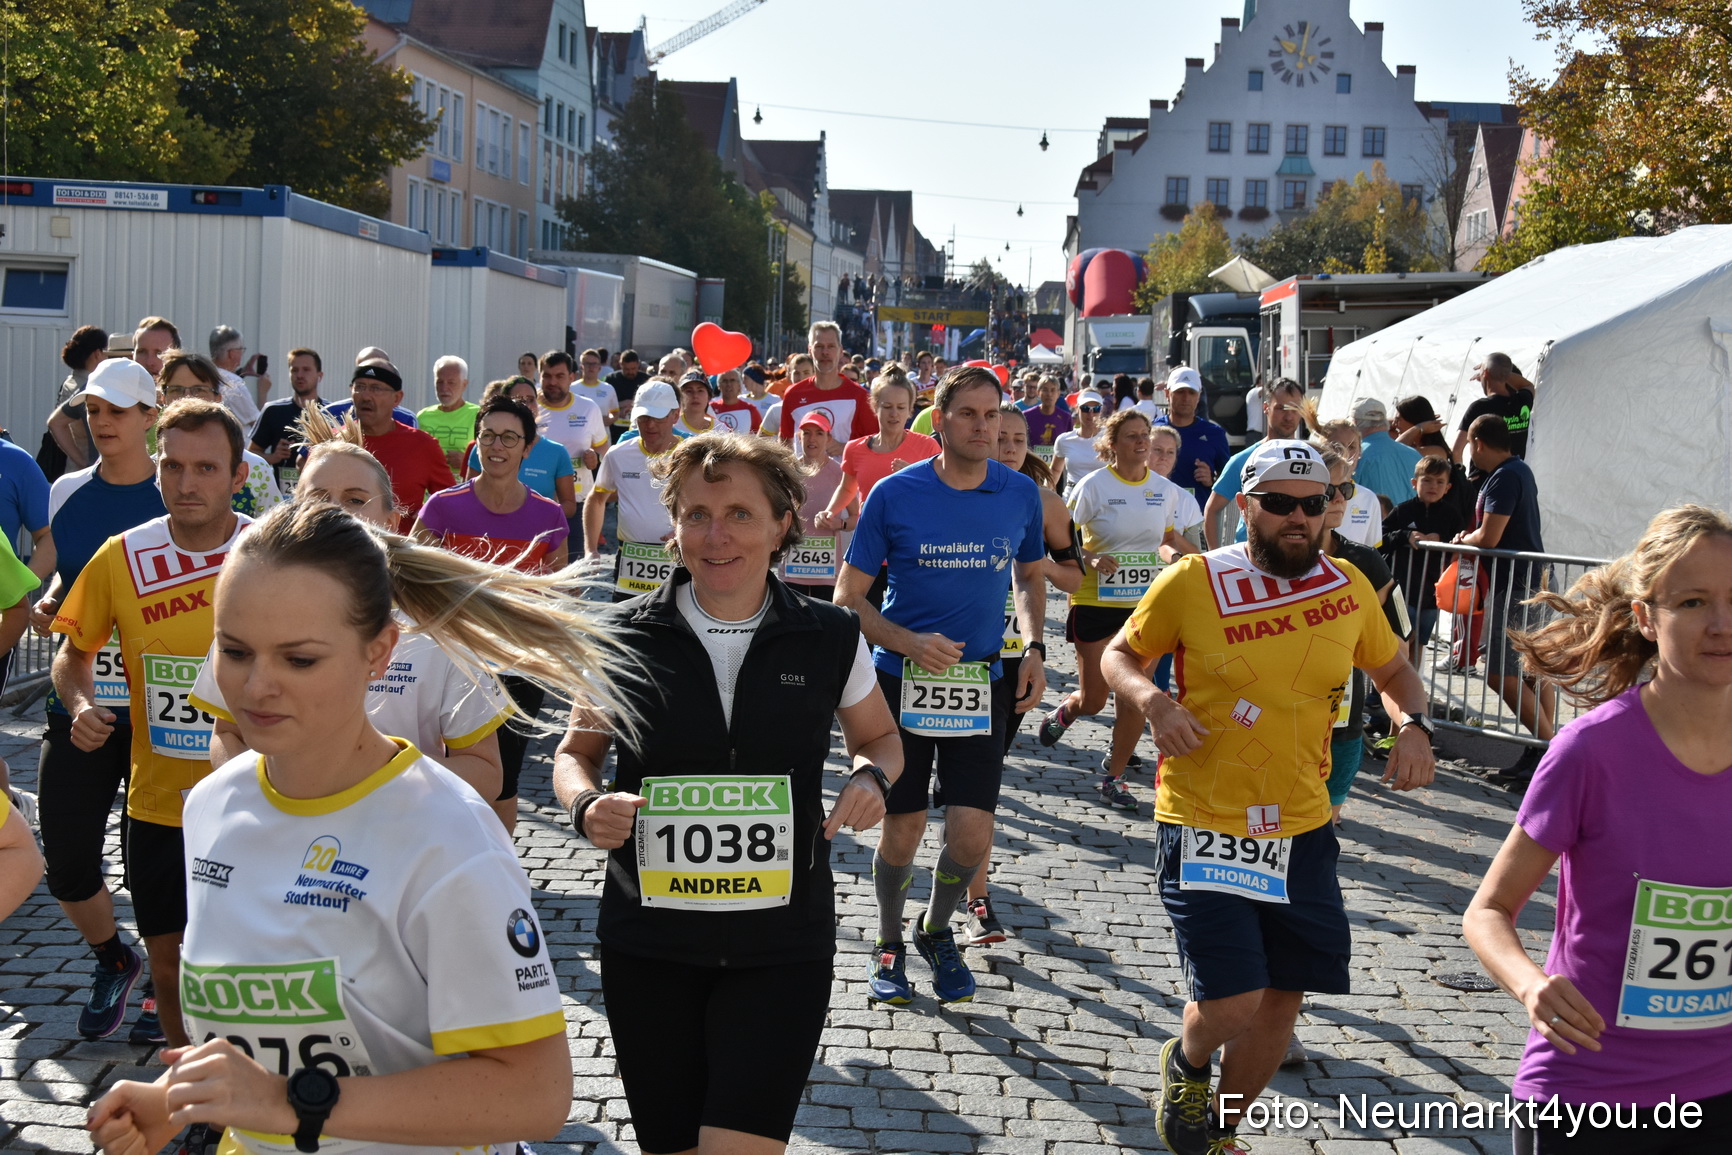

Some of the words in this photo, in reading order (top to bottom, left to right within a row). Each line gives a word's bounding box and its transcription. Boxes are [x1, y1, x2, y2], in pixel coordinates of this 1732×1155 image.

[913, 311, 951, 321] START
[791, 550, 831, 564] 2649
[920, 542, 985, 554] Kirwaläufer
[917, 557, 987, 568] Pettenhofen
[1115, 552, 1153, 565] OCK
[626, 561, 671, 580] 1296
[792, 566, 829, 574] STEFANIE
[1105, 569, 1151, 584] 2199
[628, 581, 661, 592] HARAL
[1113, 588, 1142, 596] MARIA
[141, 590, 211, 625] MAX
[1223, 614, 1298, 645] MAX
[1302, 594, 1360, 627] BÖGL
[152, 659, 202, 684] BO
[781, 673, 805, 682] GORE
[912, 685, 981, 711] 2553
[917, 716, 974, 728] JOHANN
[165, 732, 211, 747] MICH
[649, 781, 780, 811] BOCK
[655, 823, 776, 864] 1038
[1195, 830, 1279, 870] 2394
[304, 844, 338, 872] 20
[192, 857, 235, 883] BOCK
[333, 862, 366, 878] JAHRE
[1202, 867, 1269, 891] THOMAS
[294, 873, 368, 901] Neumarkter
[669, 877, 763, 894] ANDREA
[284, 890, 351, 913] Stadtlauf
[1648, 889, 1732, 925] BO
[515, 963, 549, 981] PARTL
[183, 970, 329, 1017] BOCK
[517, 977, 551, 992] Neumarkt
[1647, 991, 1732, 1013] SUSAN
[204, 1032, 351, 1077] 76
